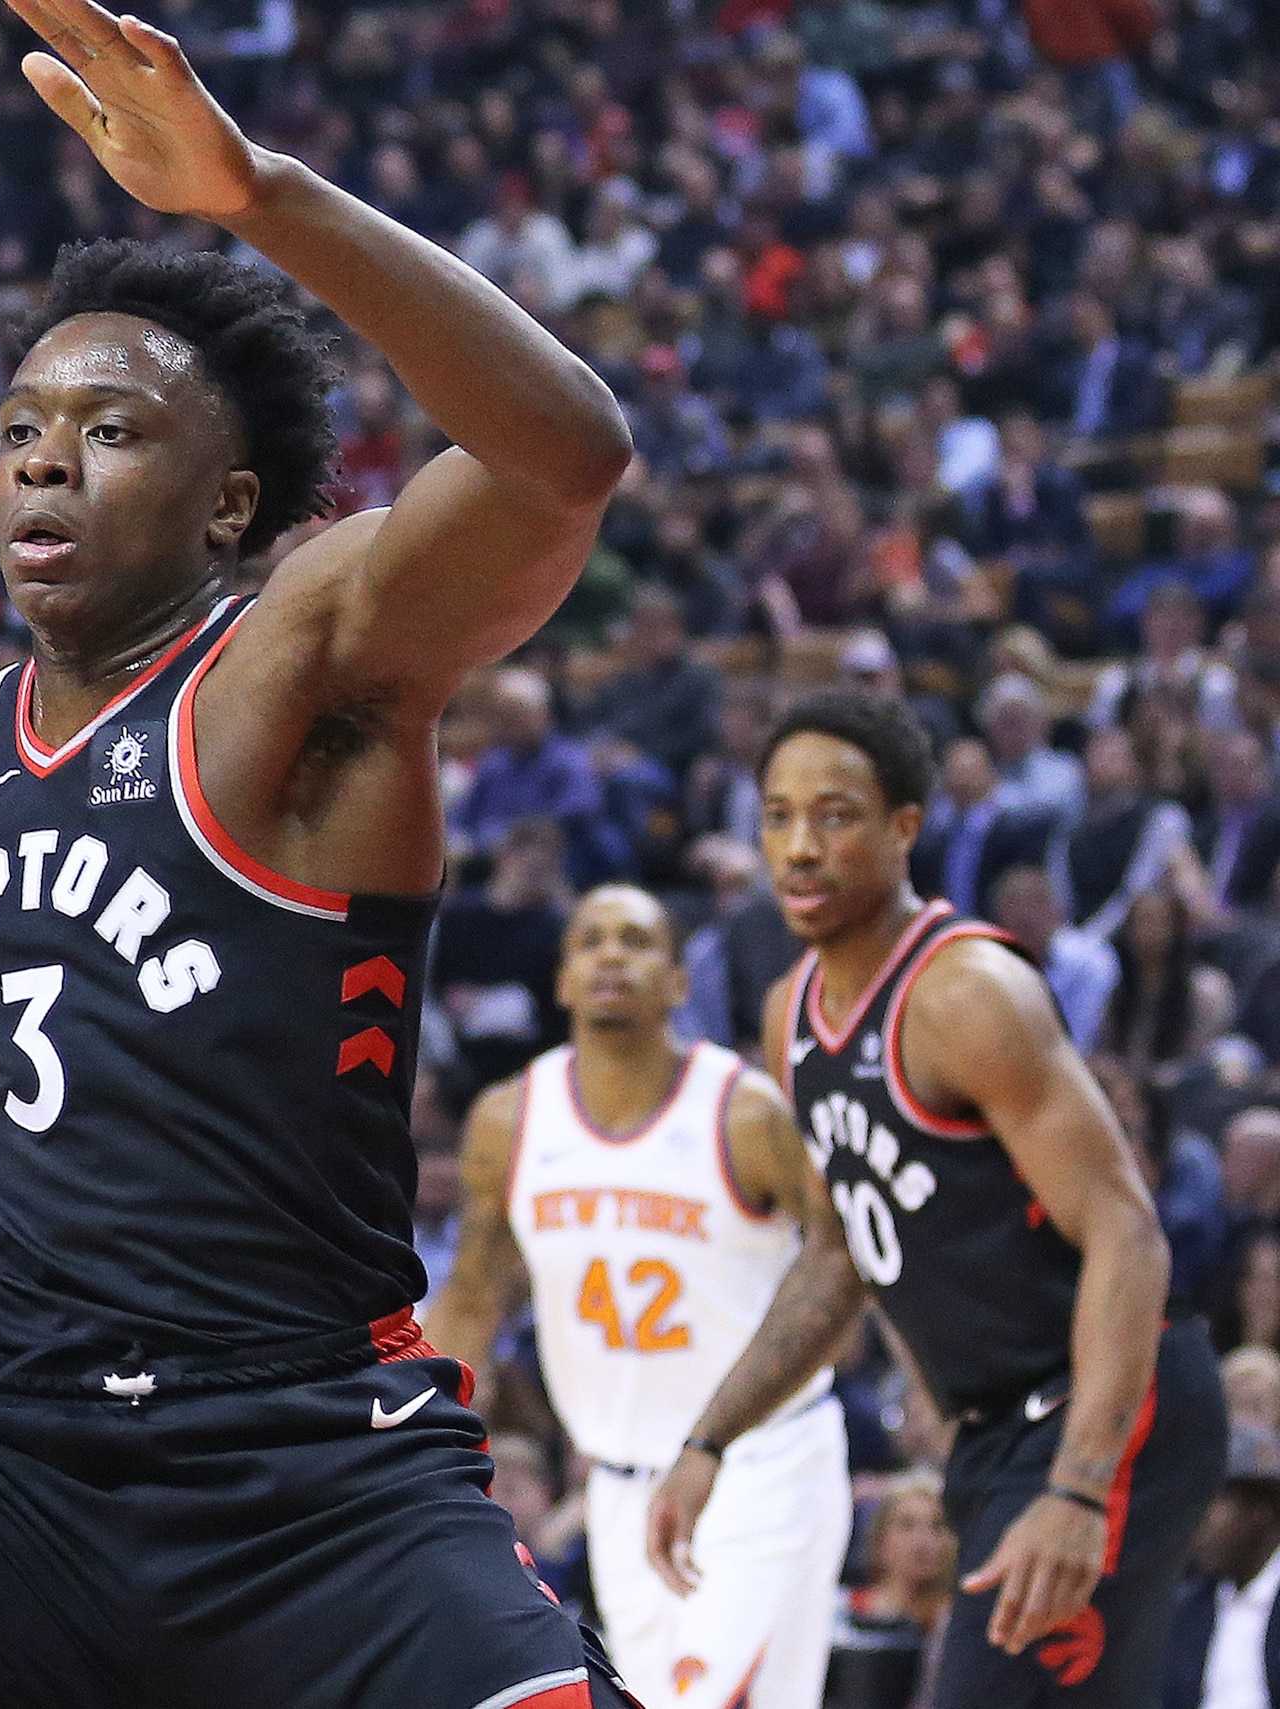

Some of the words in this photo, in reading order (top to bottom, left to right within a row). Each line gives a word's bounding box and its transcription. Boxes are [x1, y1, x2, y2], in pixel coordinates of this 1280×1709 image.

[90, 785, 122, 805] Sun
[123, 778, 157, 800] Life
[0, 963, 66, 1134] 3
[531, 1187, 606, 1233] NEW
[610, 1187, 711, 1244] YORK
[577, 1257, 692, 1353] 42
